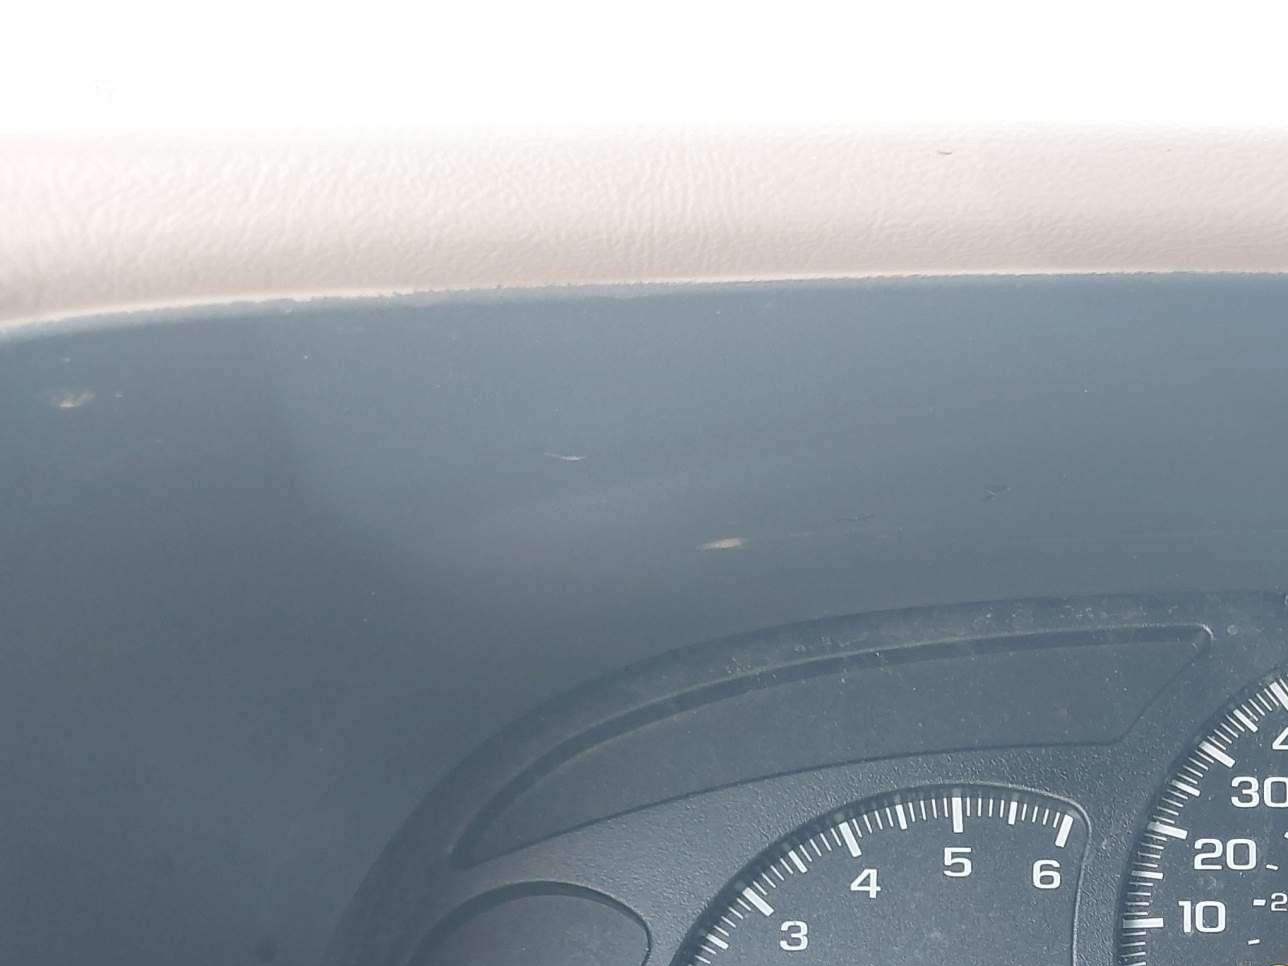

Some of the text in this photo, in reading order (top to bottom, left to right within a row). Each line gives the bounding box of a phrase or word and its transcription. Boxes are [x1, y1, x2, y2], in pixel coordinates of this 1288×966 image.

[943, 847, 973, 878] 5
[1193, 838, 1257, 871] 20
[850, 868, 881, 899] 4
[1032, 859, 1062, 889] 6
[1178, 900, 1226, 933] 10
[780, 920, 809, 951] 3
